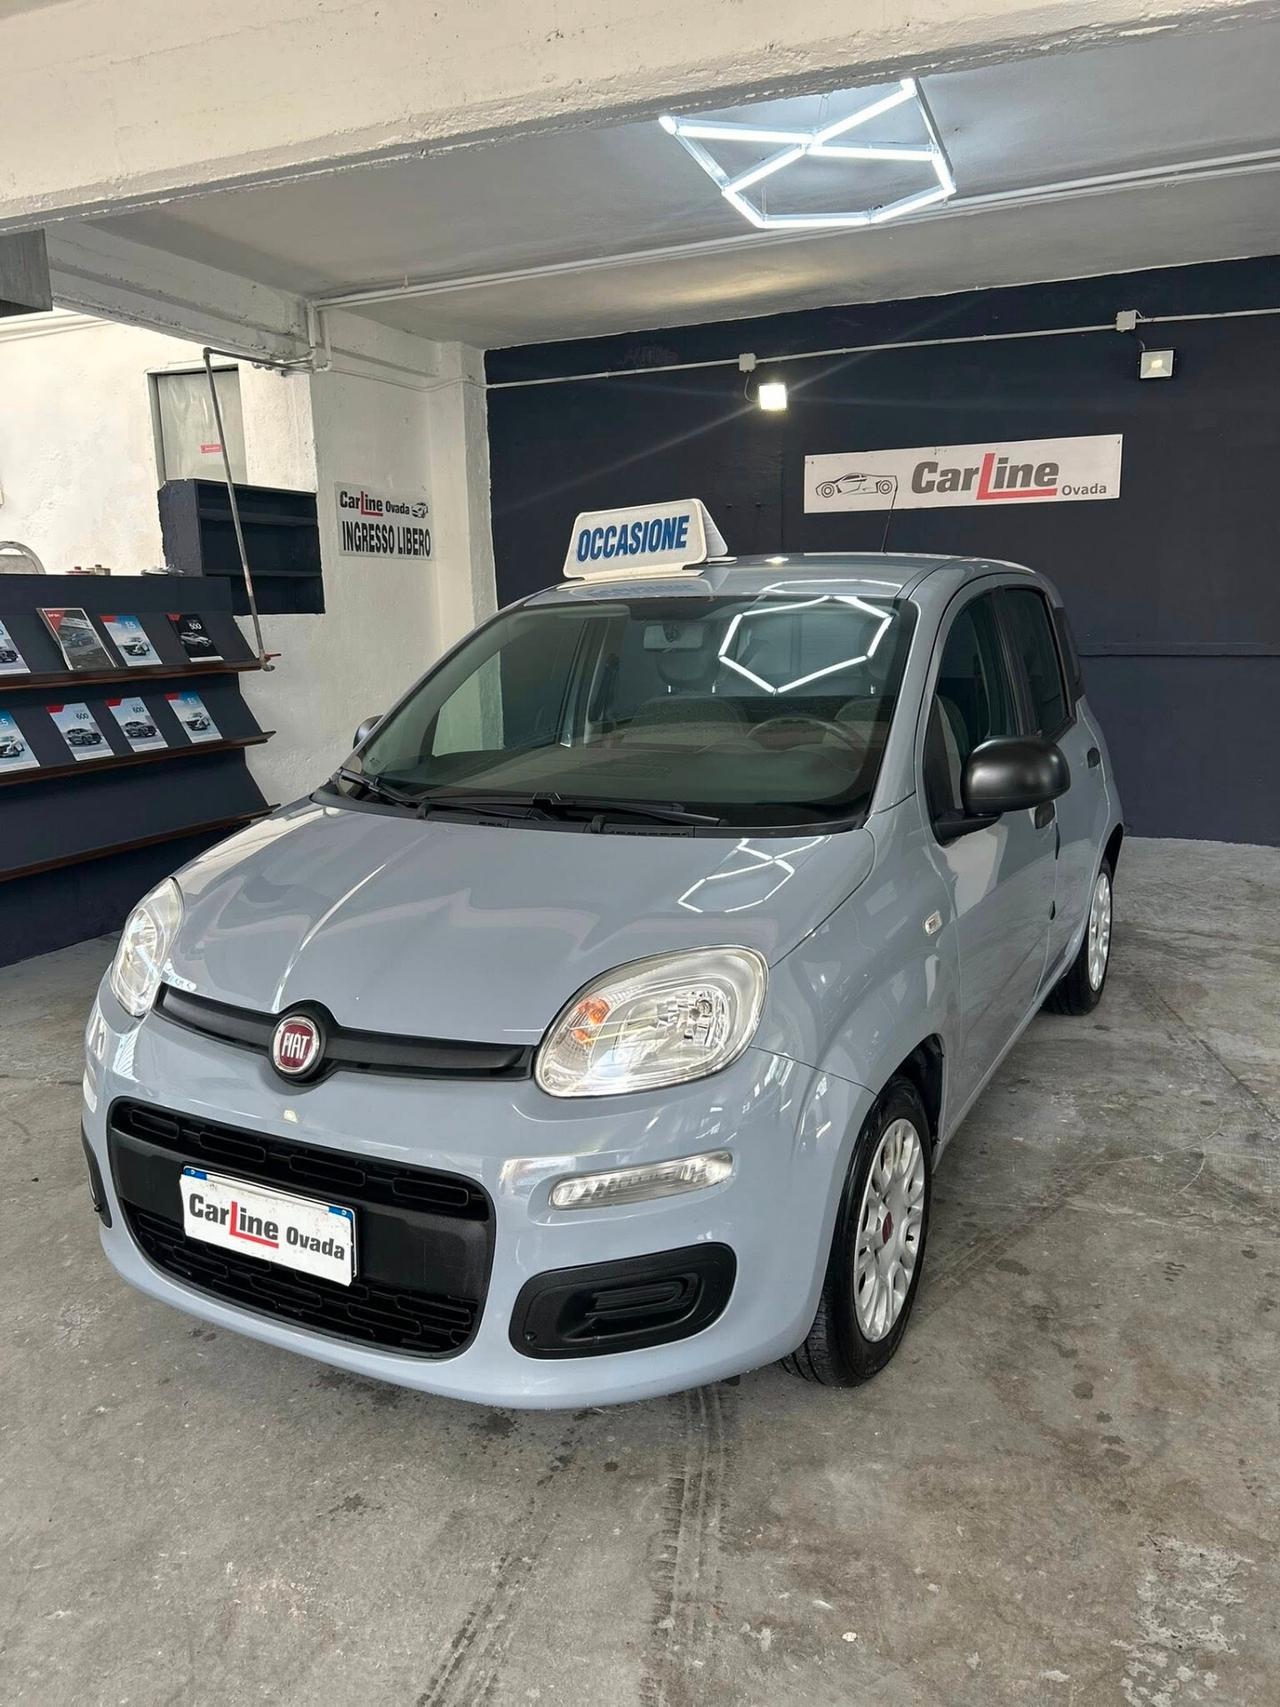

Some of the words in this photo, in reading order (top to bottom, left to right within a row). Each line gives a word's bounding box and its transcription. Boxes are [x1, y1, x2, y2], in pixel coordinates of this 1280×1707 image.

[911, 453, 1059, 500] CarLine
[1061, 483, 1107, 496] Ovada
[340, 491, 383, 516] CarLine
[386, 501, 410, 515] Ovada
[342, 521, 395, 554] INGRESSO
[397, 526, 431, 557] LIBERO
[577, 515, 690, 562] OCCASIONE
[281, 1032, 310, 1060] FIAT
[189, 1193, 279, 1248] CarLine
[286, 1226, 345, 1261] Ovada
